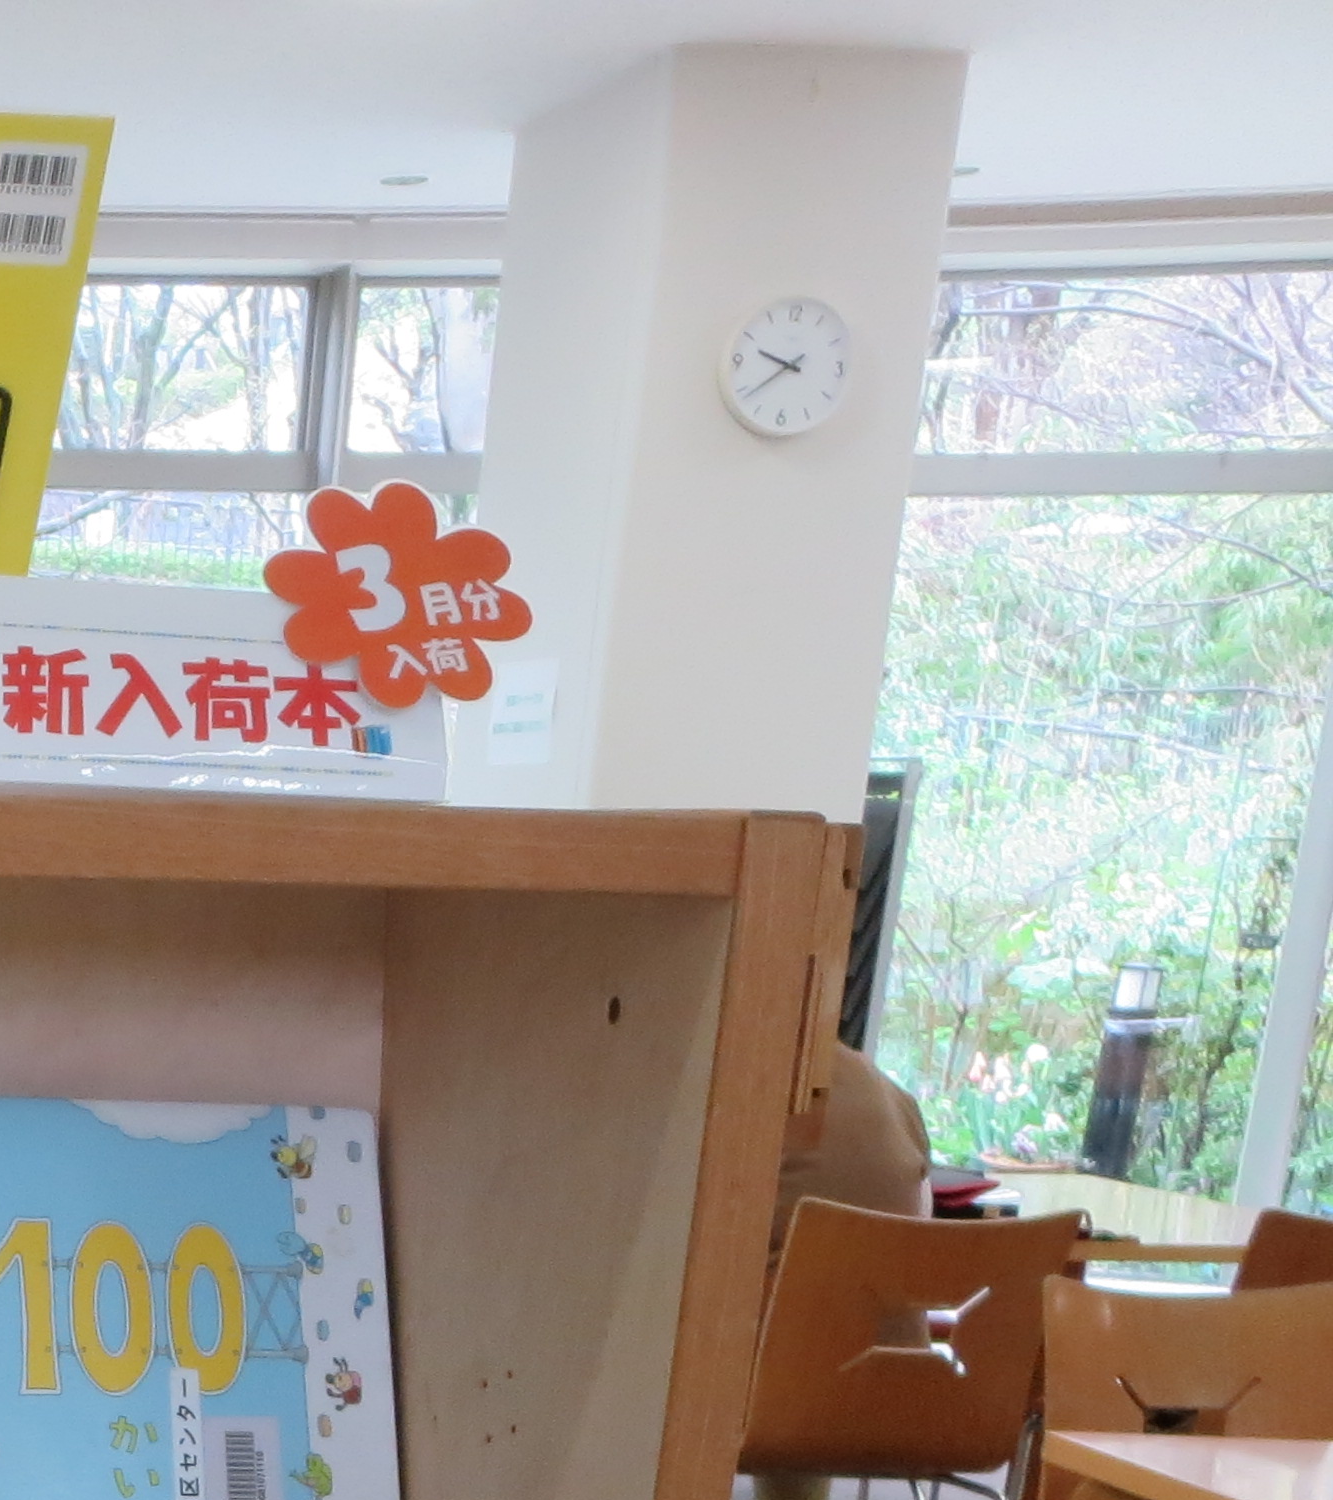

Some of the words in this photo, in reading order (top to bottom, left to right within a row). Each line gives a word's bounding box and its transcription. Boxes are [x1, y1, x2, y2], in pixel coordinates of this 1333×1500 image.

[386, 637, 470, 680] 入荷
[1, 646, 361, 748] 新入荷本
